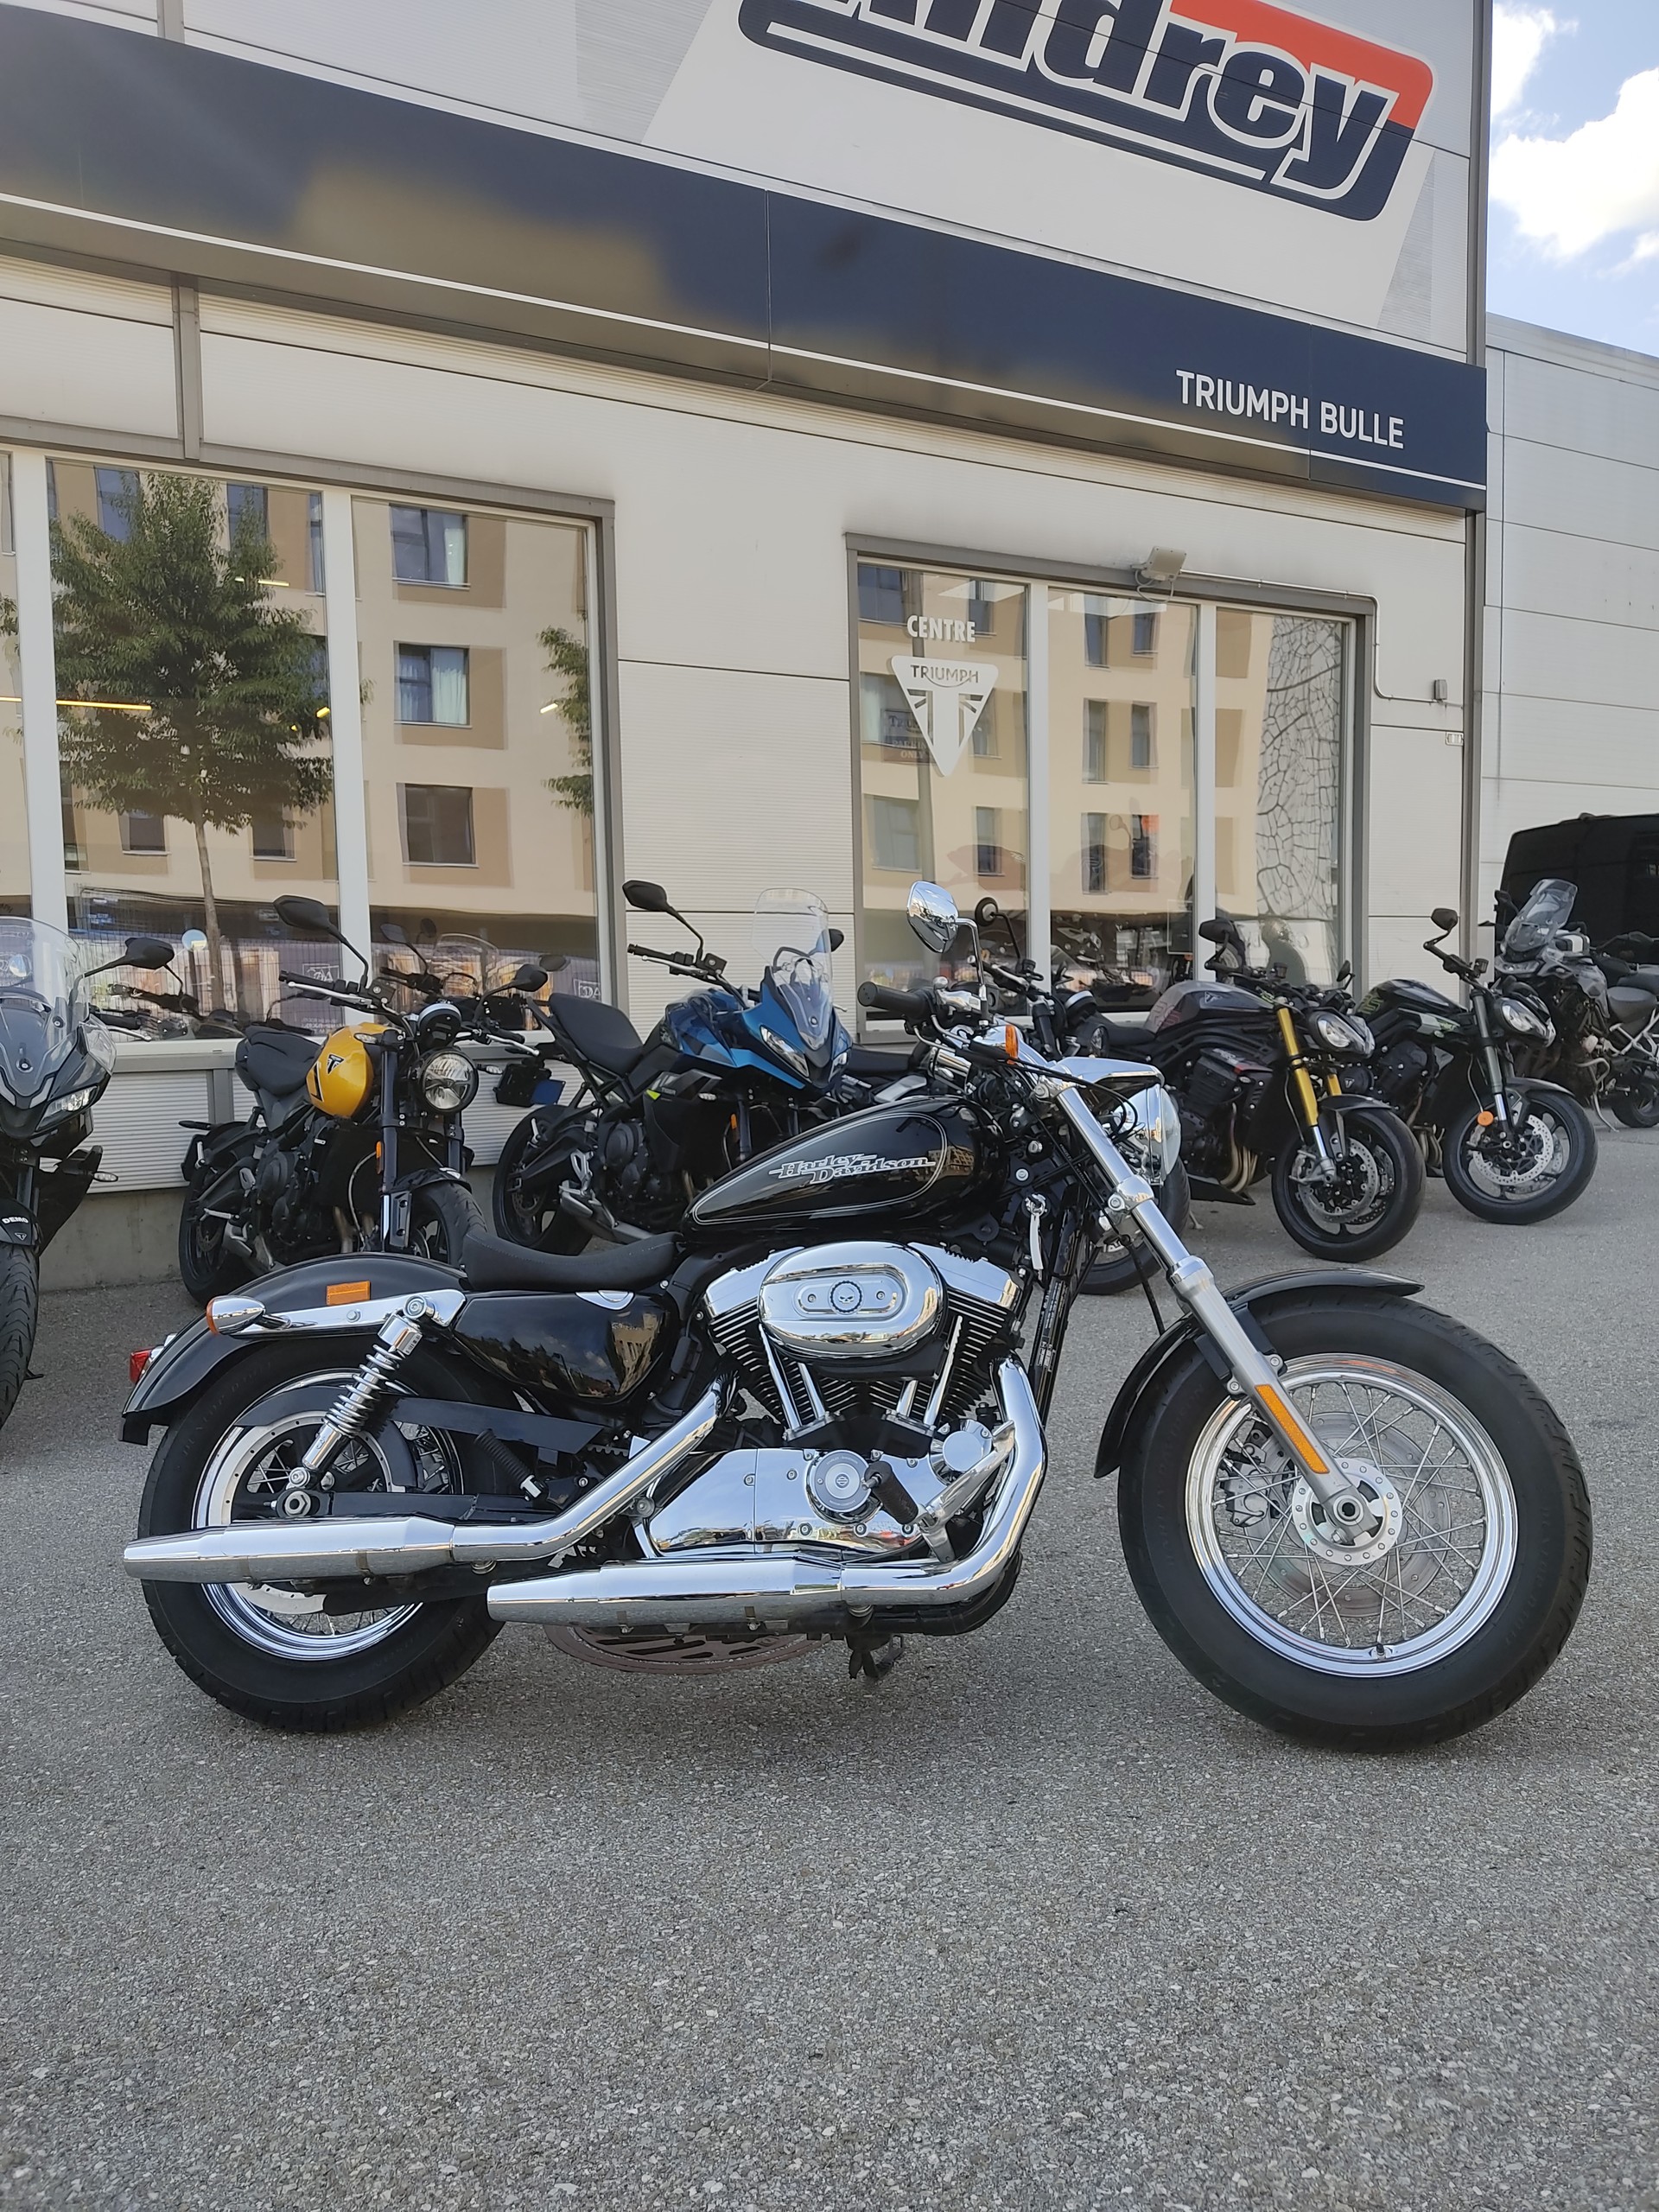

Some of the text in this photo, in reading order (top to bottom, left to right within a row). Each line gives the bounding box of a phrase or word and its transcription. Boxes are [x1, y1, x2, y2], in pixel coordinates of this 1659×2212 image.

[793, 0, 1391, 192] ndrey
[1175, 369, 1405, 449] TRIUMPH BULLE
[907, 614, 976, 643] CENTRE
[910, 664, 980, 685] TRIUMPH
[2, 1216, 29, 1224] DEMO
